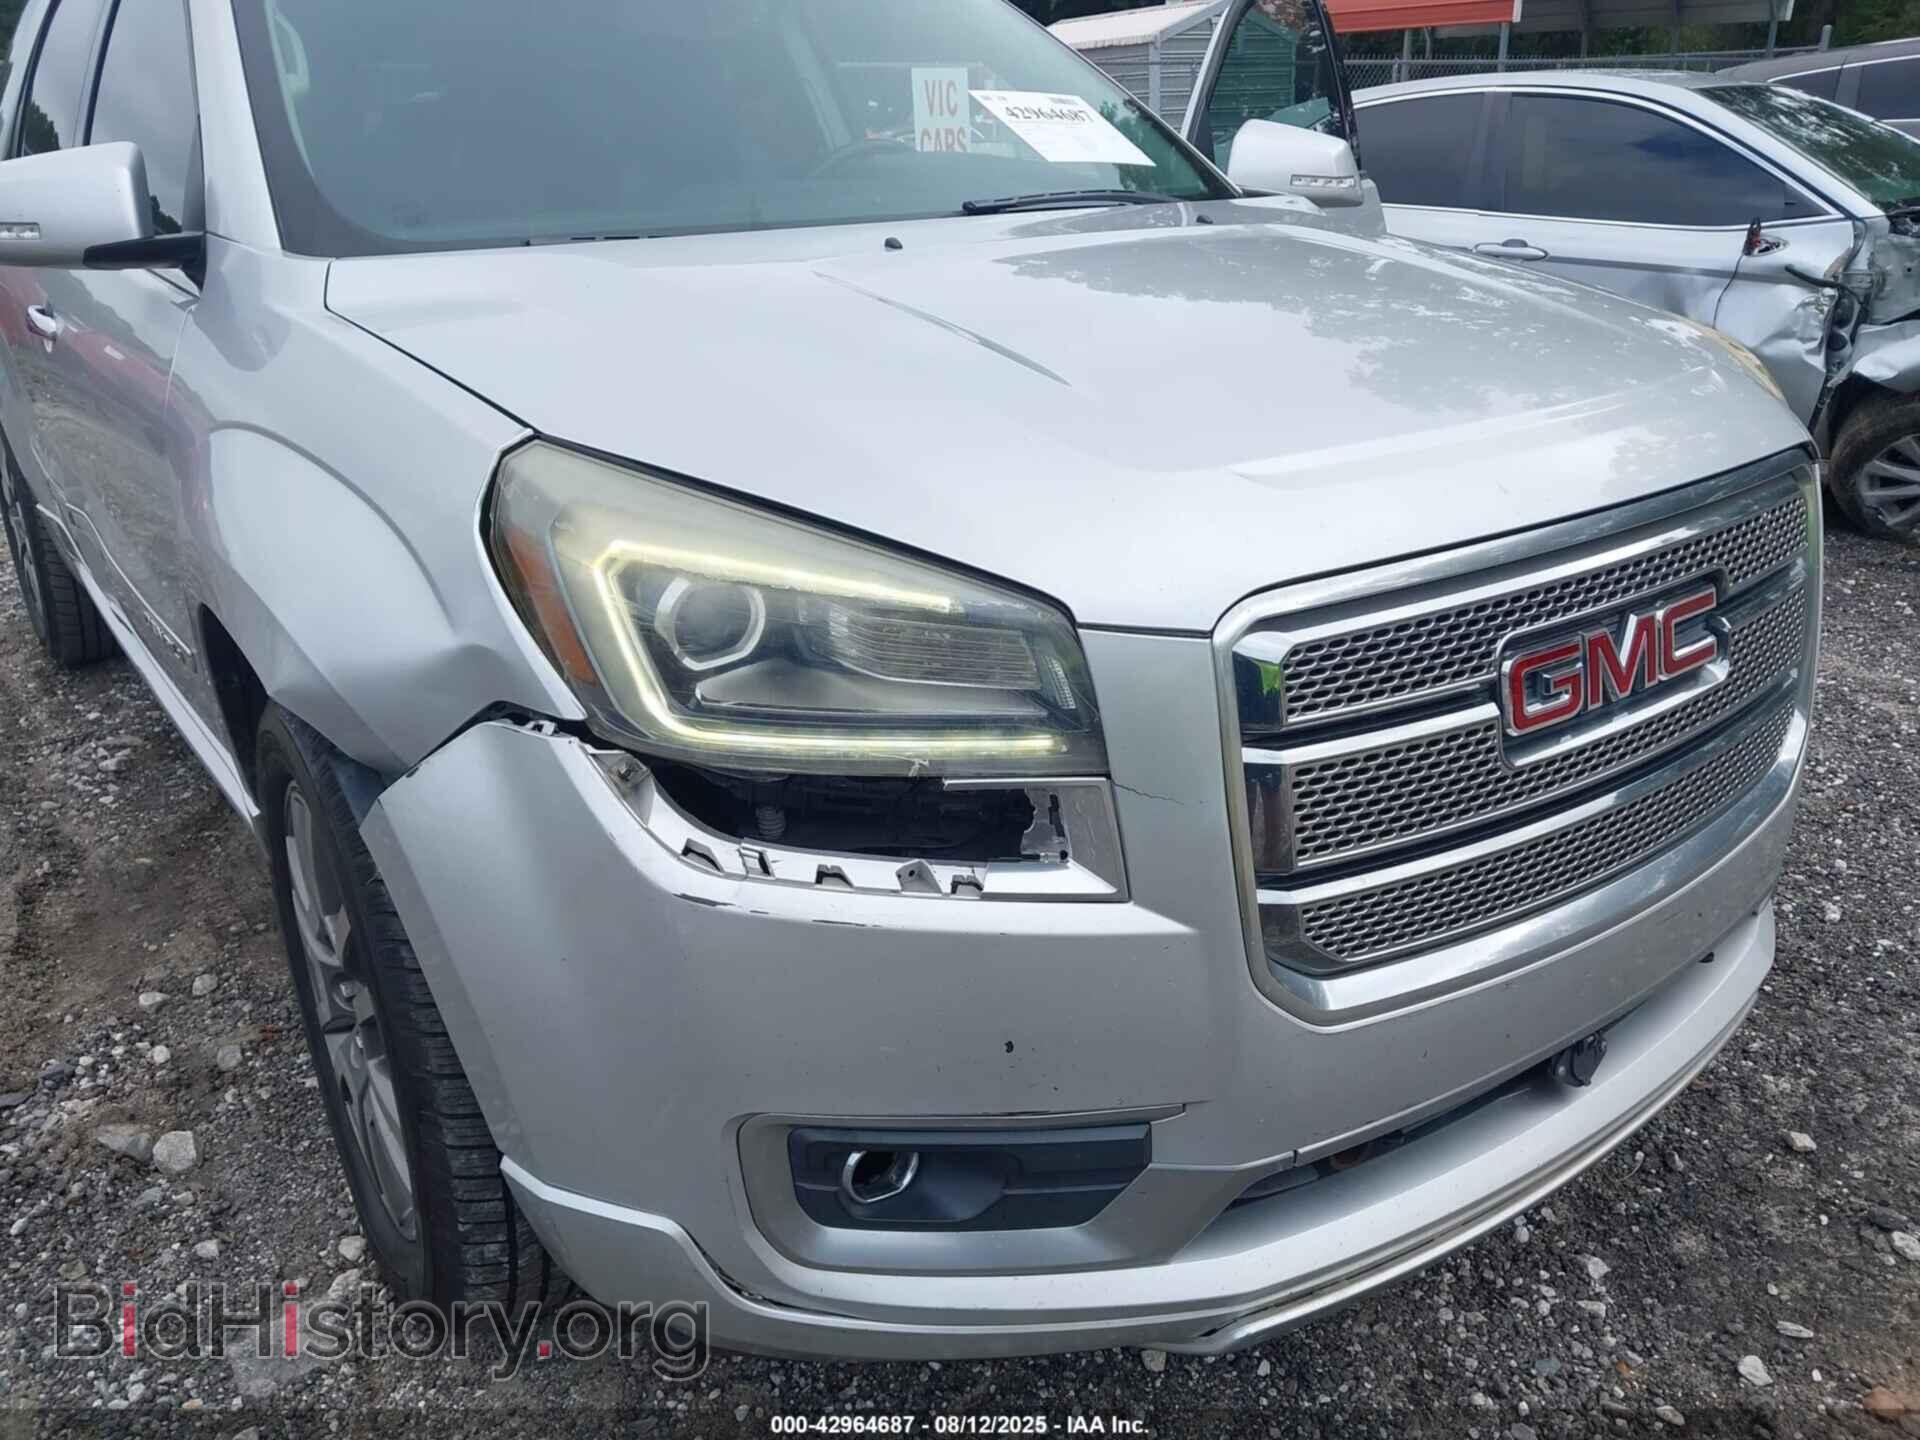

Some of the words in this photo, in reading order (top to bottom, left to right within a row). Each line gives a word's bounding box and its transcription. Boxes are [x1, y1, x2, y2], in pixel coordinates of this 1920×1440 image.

[924, 79, 958, 117] VIC
[1004, 106, 1094, 122] 42964687
[1504, 586, 1717, 735] GMC
